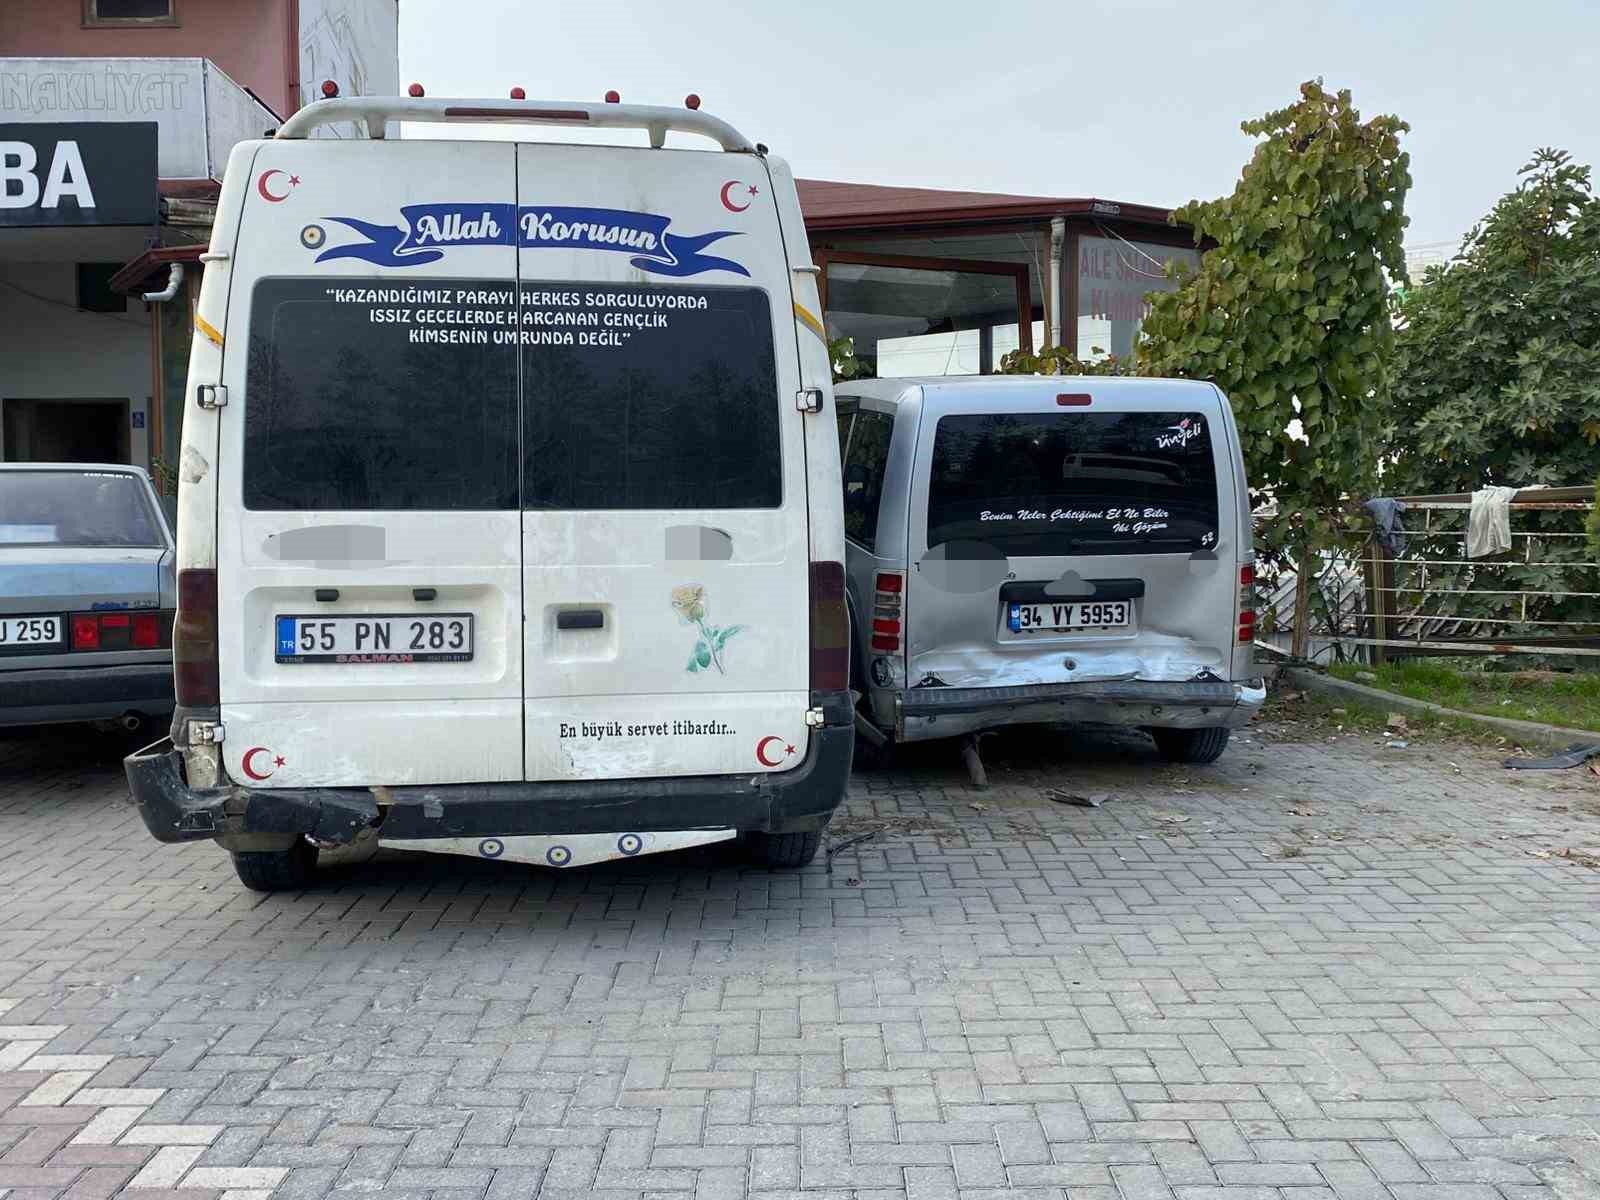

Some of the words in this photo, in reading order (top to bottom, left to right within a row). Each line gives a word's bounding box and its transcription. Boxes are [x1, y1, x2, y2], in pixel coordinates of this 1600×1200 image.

[416, 212, 501, 244] Allah
[520, 212, 657, 250] Korusun
[456, 290, 514, 305] PARAYI
[520, 291, 581, 307] HERKES
[585, 293, 708, 310] SORGULUYORDA
[369, 308, 411, 323] ISSIZ
[415, 309, 505, 325] GECELERDE
[603, 311, 669, 330] GENÇLİK
[409, 326, 489, 345] KİMSENİN
[493, 330, 574, 346] UMRUNDA
[980, 510, 1014, 521] Benim
[1016, 509, 1048, 521] Neler
[1105, 508, 1121, 520] El
[1123, 508, 1140, 519] Ne
[1143, 507, 1169, 518] Bilir
[1021, 606, 1042, 626] 34
[1052, 605, 1073, 626] VY
[1079, 603, 1126, 624] 5953
[16, 619, 56, 642] 259
[301, 622, 336, 651] 55
[354, 621, 391, 650] PN
[409, 620, 464, 650] 283
[281, 640, 295, 650] TR
[335, 654, 414, 663] SALMAN
[559, 723, 577, 738] En
[581, 722, 622, 740] büyük
[627, 722, 668, 736] servet
